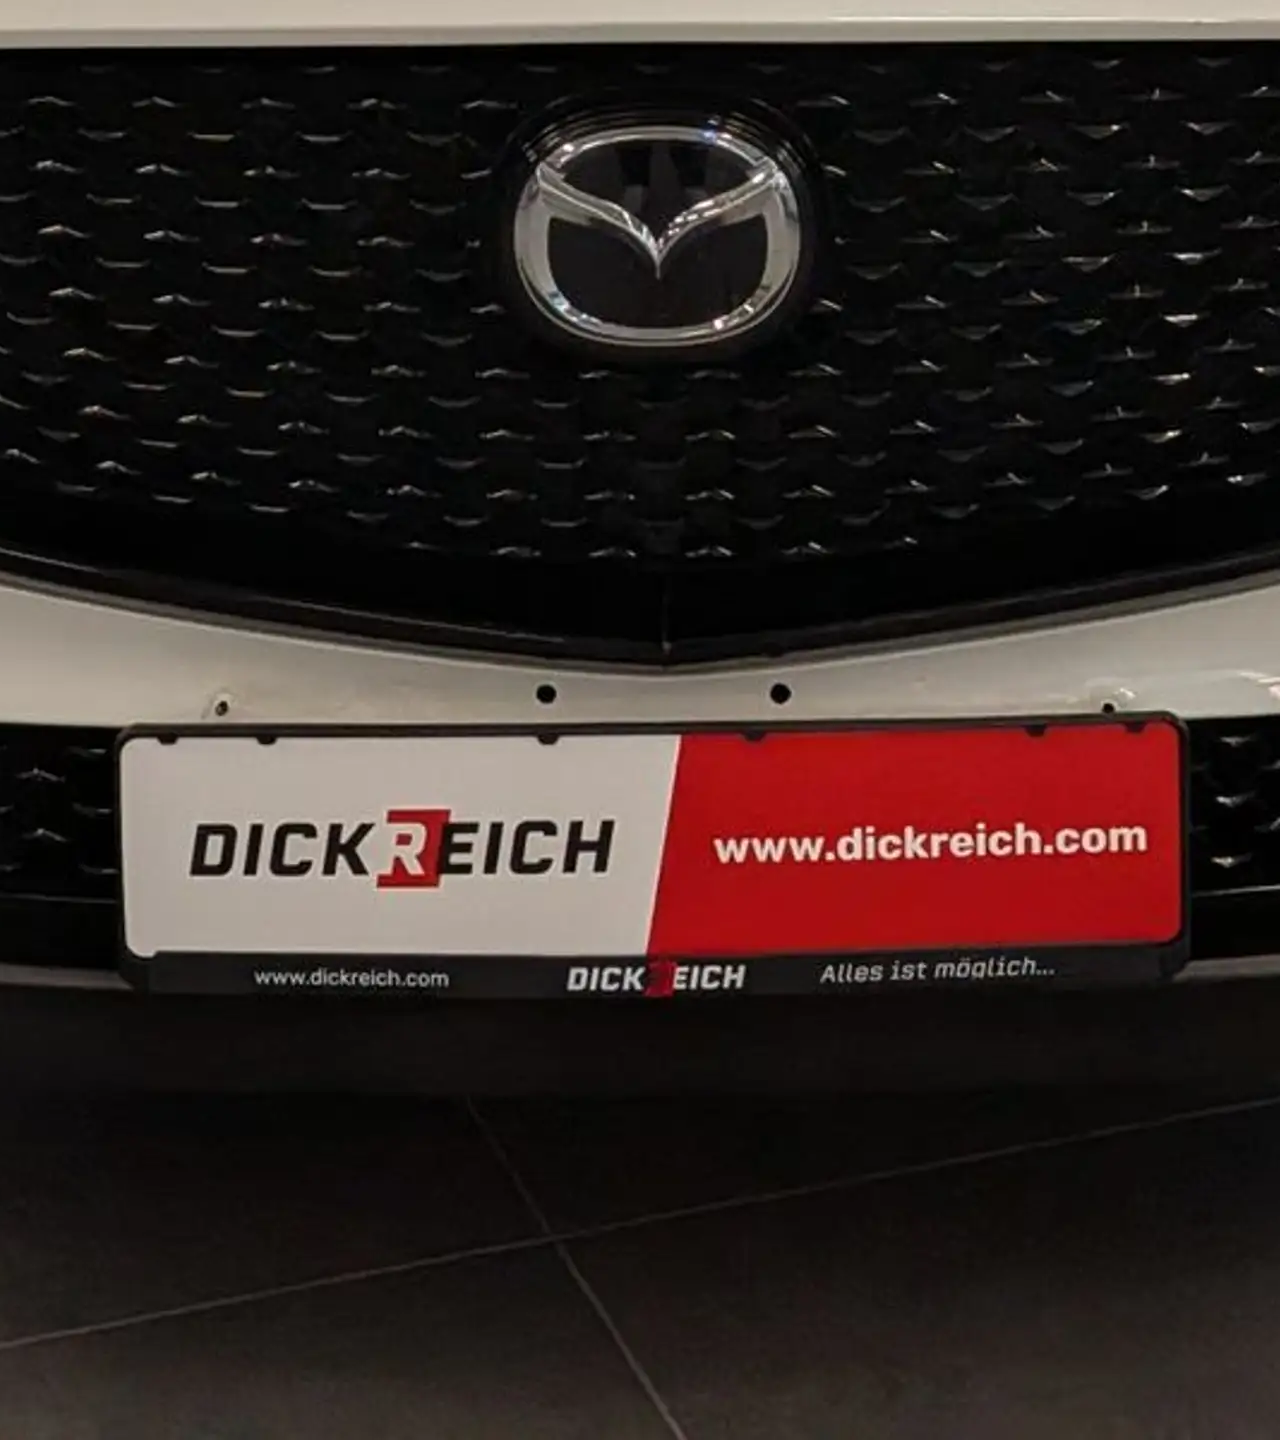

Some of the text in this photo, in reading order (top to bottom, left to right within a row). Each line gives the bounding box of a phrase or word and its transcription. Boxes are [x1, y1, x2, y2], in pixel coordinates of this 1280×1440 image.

[189, 810, 617, 888] DICKREICH
[713, 822, 1148, 863] www.dickreich.com
[254, 968, 450, 988] www.dickreich.com
[819, 957, 1056, 985] Alles ist möglich...
